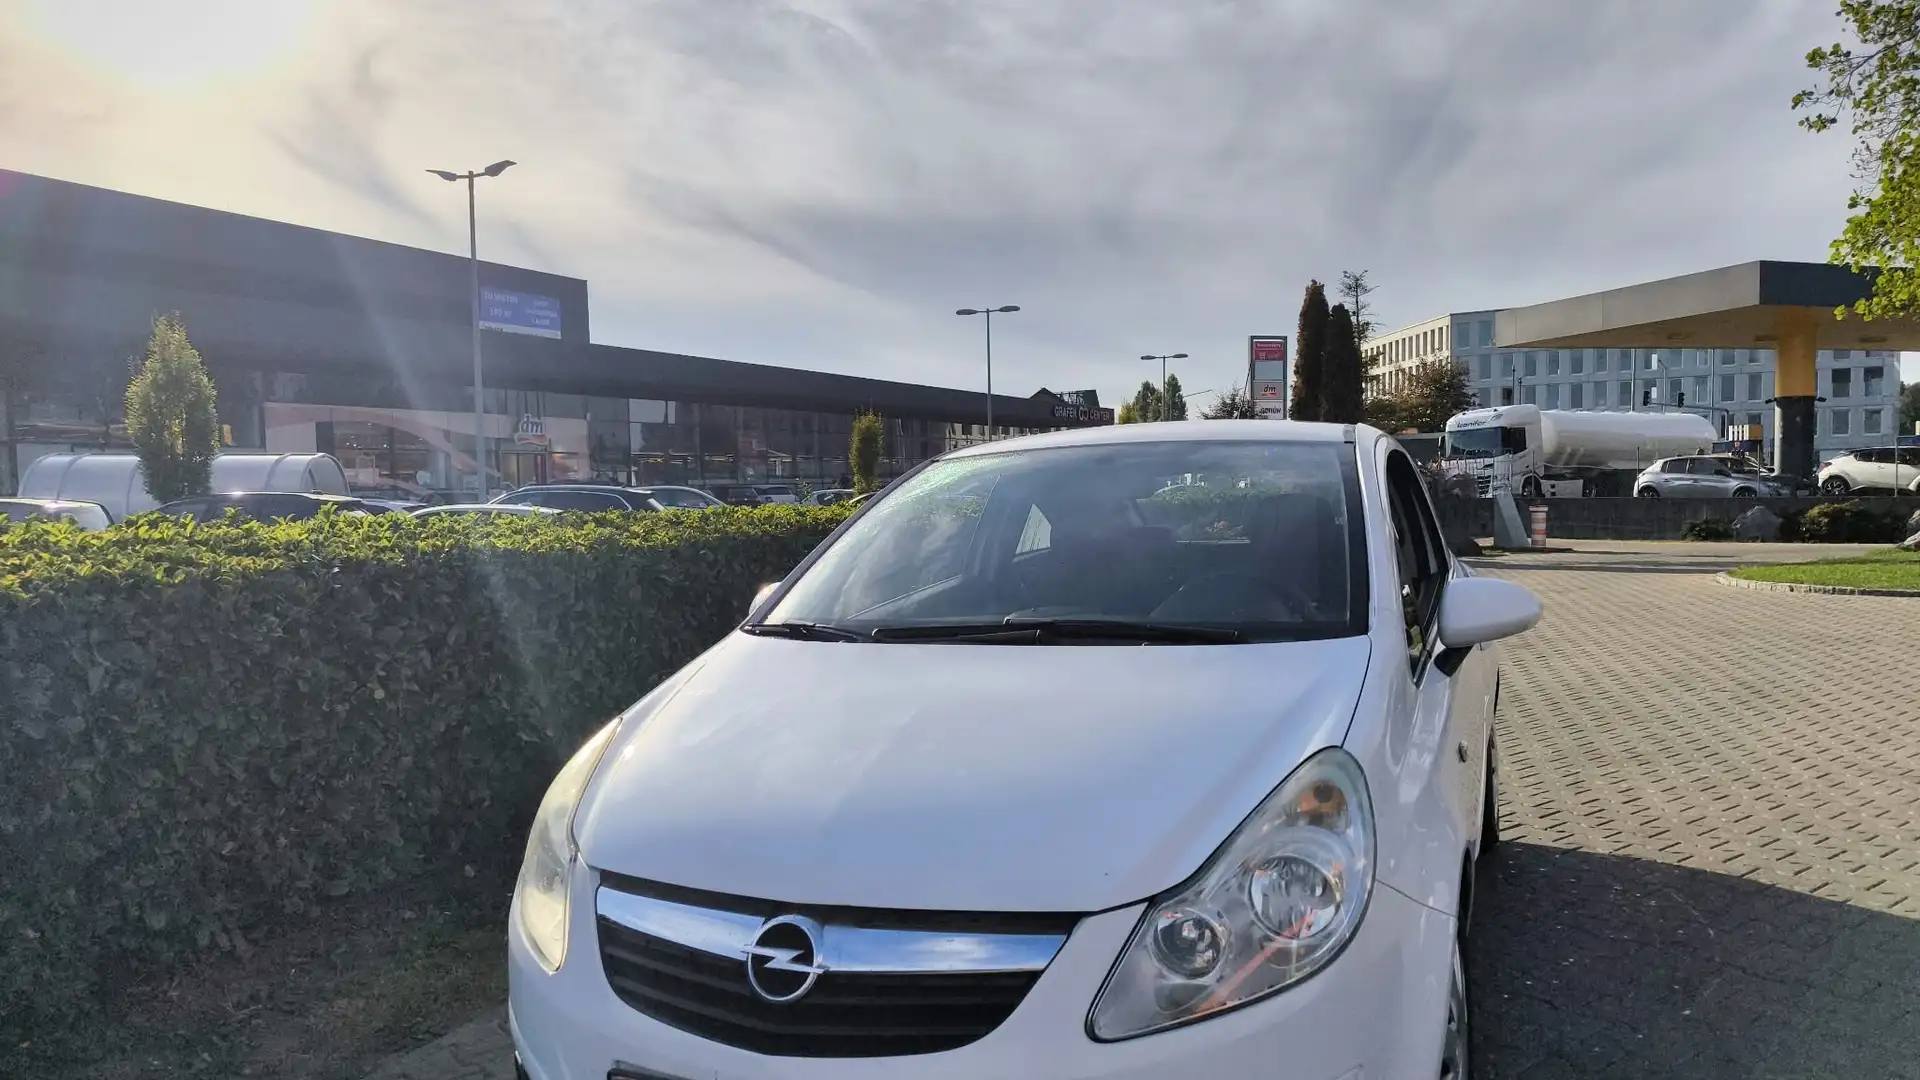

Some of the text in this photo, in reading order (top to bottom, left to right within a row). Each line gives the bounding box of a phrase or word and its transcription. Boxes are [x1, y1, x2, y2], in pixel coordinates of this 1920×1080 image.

[1263, 384, 1276, 392] dm
[1089, 409, 1110, 420] CENTER
[520, 414, 543, 435] dm
